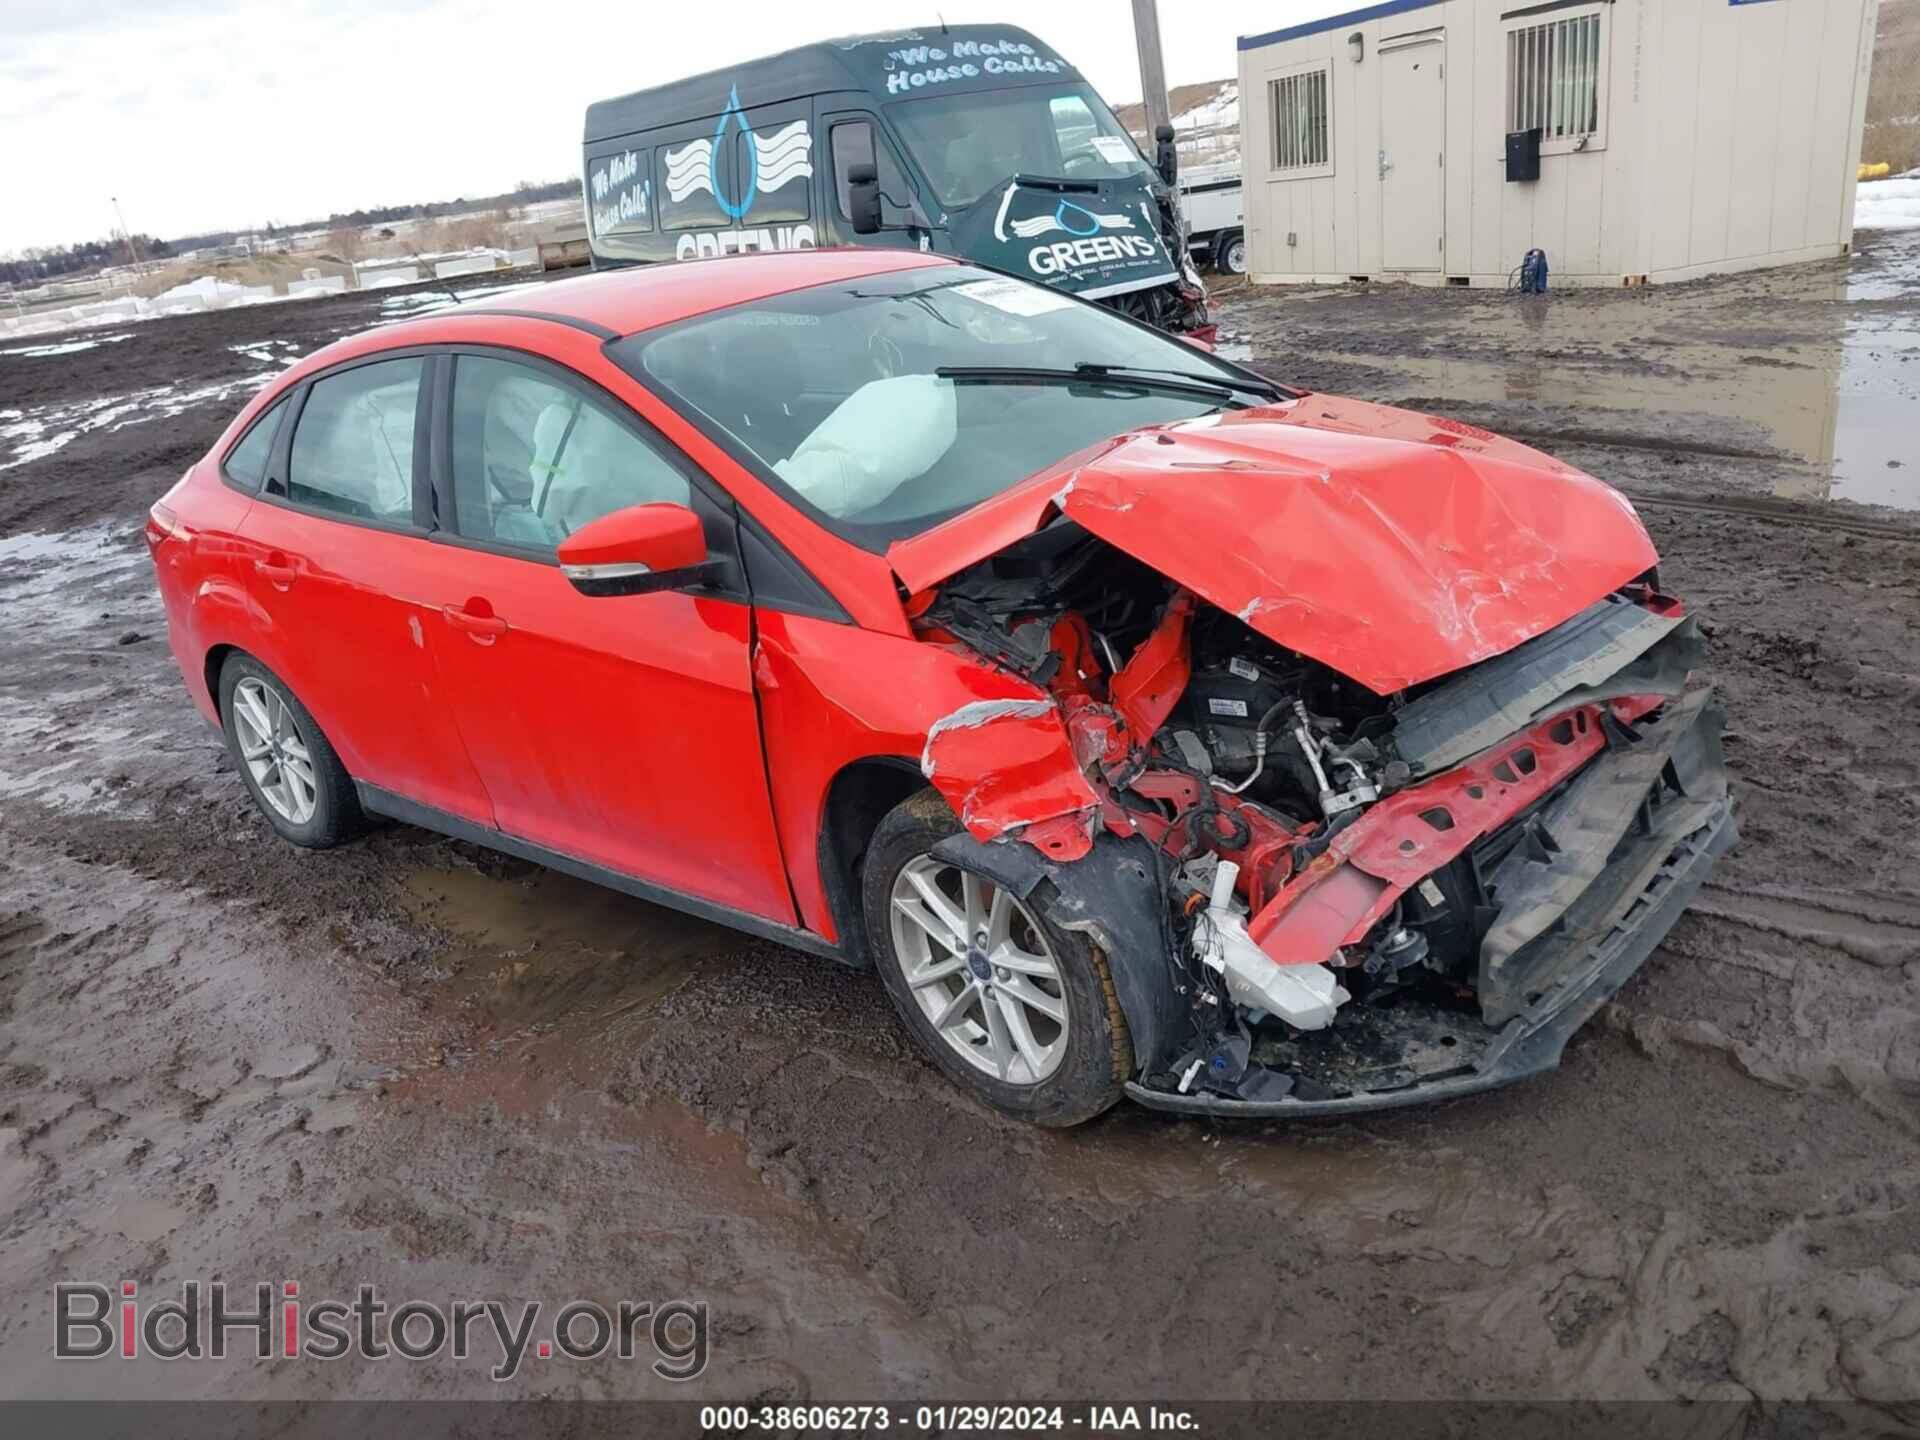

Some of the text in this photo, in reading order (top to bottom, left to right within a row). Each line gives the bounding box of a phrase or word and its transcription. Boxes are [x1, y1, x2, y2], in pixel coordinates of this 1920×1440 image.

[952, 40, 1035, 58] Make
[886, 63, 980, 94] House
[1028, 236, 1156, 274] GREEN'S
